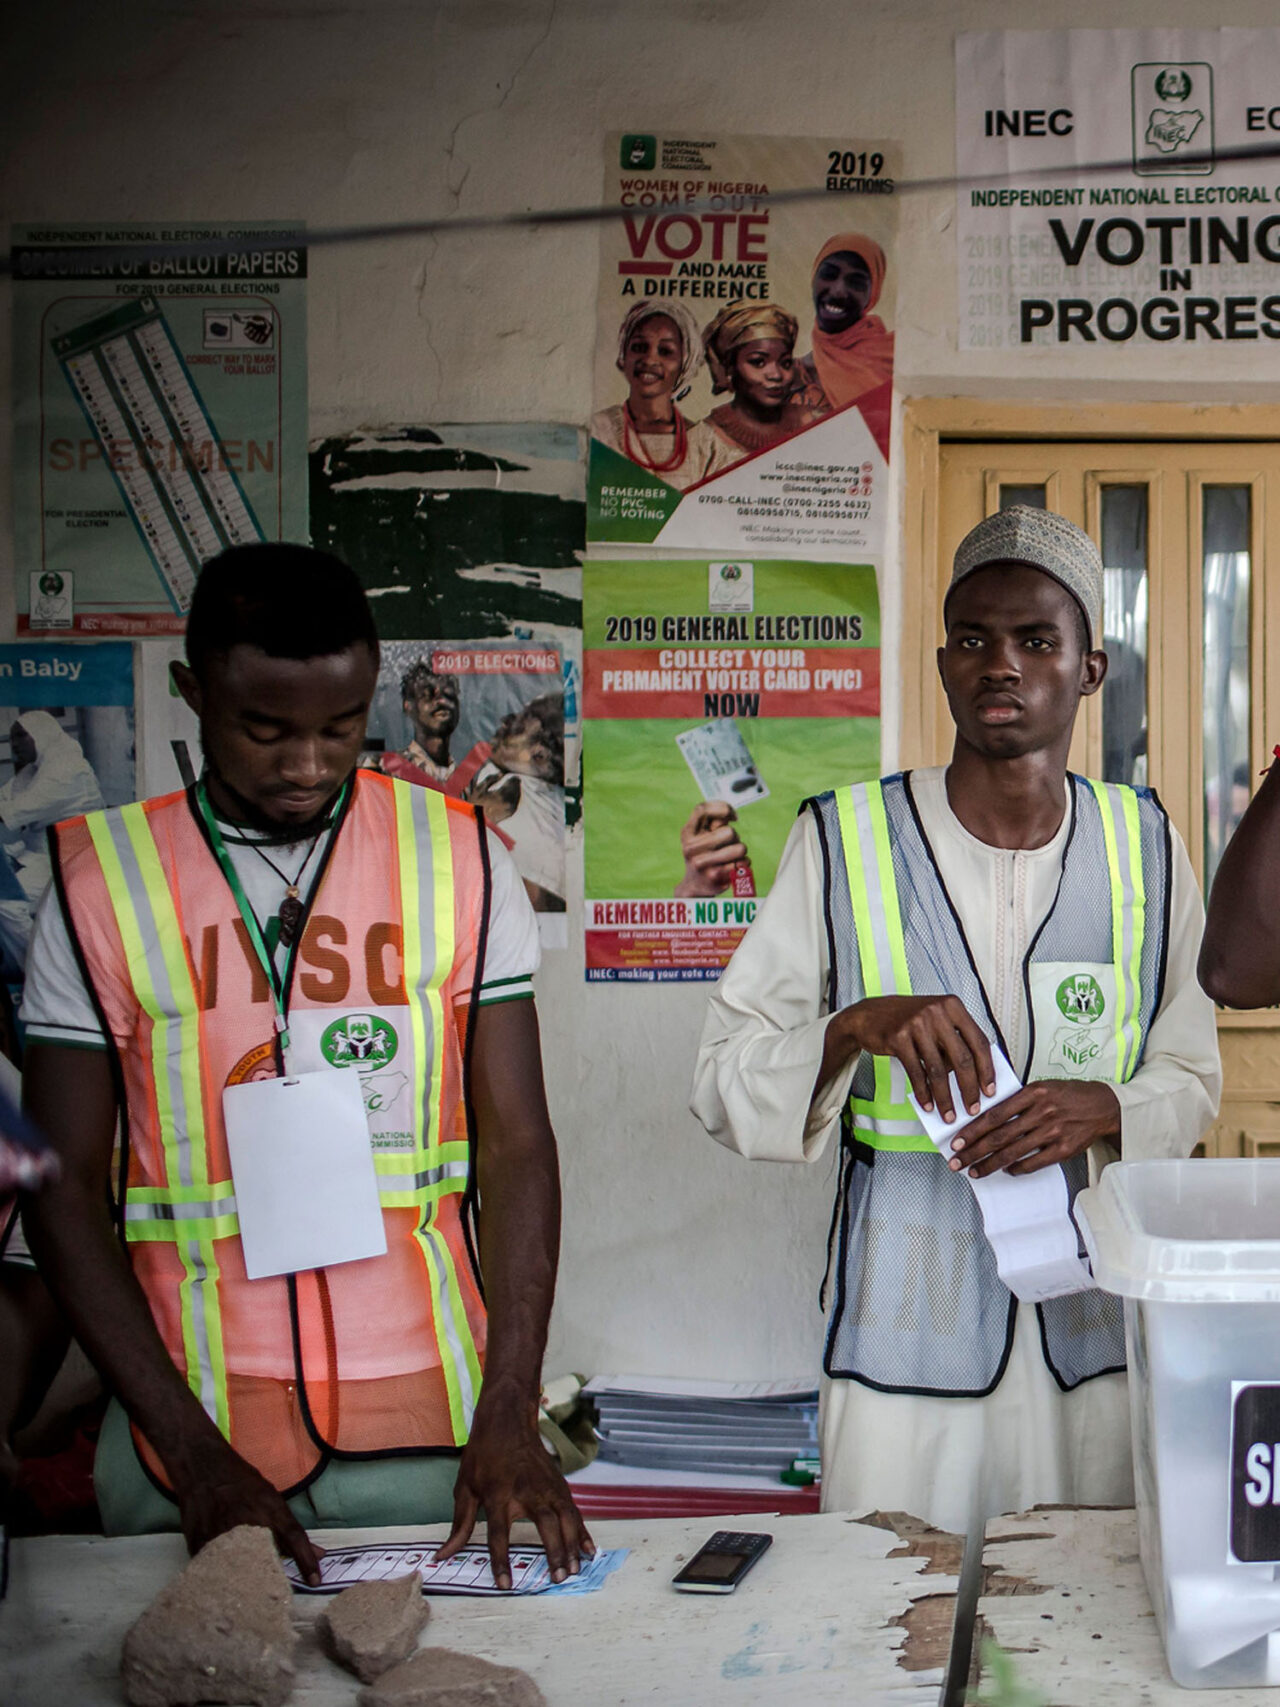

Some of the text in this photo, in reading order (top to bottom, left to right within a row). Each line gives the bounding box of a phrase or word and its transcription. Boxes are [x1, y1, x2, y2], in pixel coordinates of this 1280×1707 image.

[984, 109, 1074, 136] INEC
[827, 151, 883, 176] 2019
[619, 179, 769, 195] WOMEN OF NIGERIA
[826, 176, 895, 195] ELECTIONS
[619, 191, 696, 209] COME
[971, 189, 1085, 208] INDEPENDENT
[1089, 188, 1172, 206] NATIONAL
[1174, 186, 1270, 204] ELECTORAL
[27, 230, 297, 242] INDEPENDENT NATIONAL ELECTORAL COMMISSION
[622, 212, 769, 263] VOTE
[151, 251, 222, 274] BALLOT
[227, 250, 300, 274] PAPERS
[678, 262, 767, 279] AND MAKE
[115, 284, 139, 295] FOR
[167, 283, 218, 295] GENERAL
[220, 283, 280, 294] ELECTIONS
[621, 278, 770, 300] A DIFFERENCE
[1160, 268, 1193, 290] IN
[49, 439, 275, 473] SPECIMEN
[601, 486, 667, 499] REMEMBER
[601, 497, 647, 509] NO PVC,
[45, 510, 128, 519] FOR PRESIDENTIAL
[65, 520, 110, 528] ELECTION
[601, 508, 665, 520] NO VOTING
[606, 615, 863, 642] 2019 GENERAL ELECTIONS
[438, 654, 556, 669] 2019 ELECTIONS
[659, 649, 806, 668] COLLECT YOUR
[20, 657, 83, 682] Baby
[602, 669, 863, 692] PERMANENT VOTER CARD (PVC)
[704, 693, 760, 717] NOW
[594, 902, 757, 926] REMEMBER; NO PVC
[589, 968, 703, 980] INEC: making your vote
[1062, 1043, 1099, 1065] INEC
